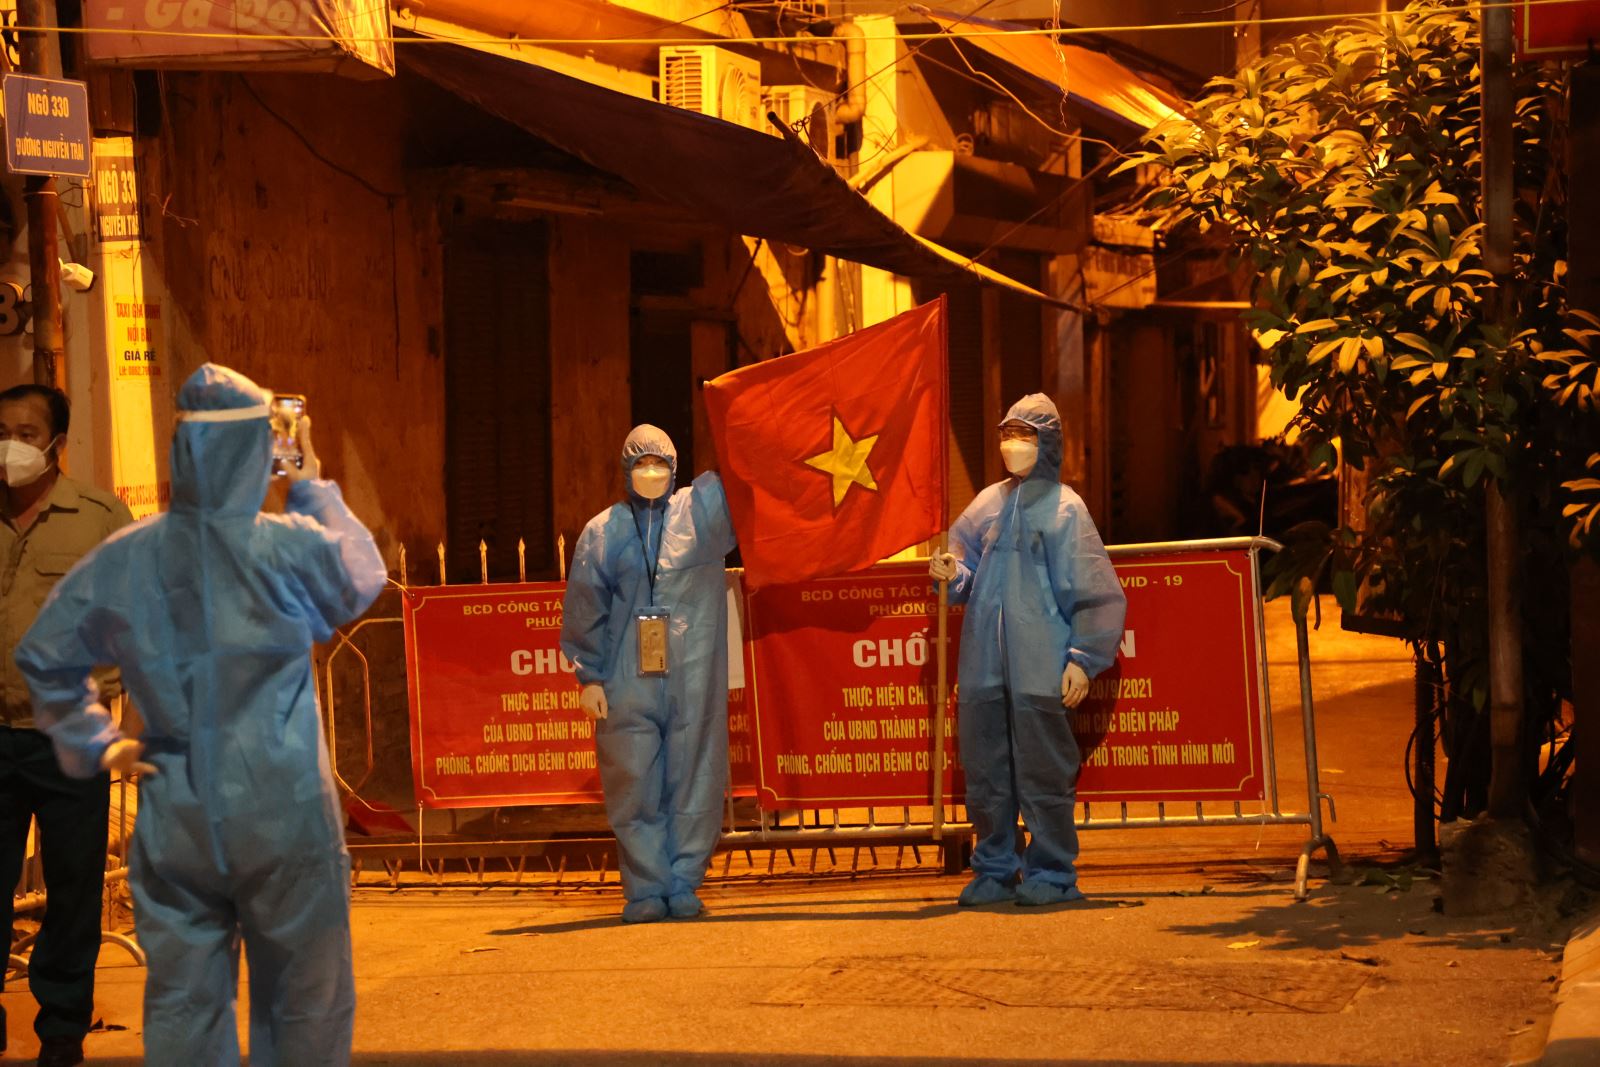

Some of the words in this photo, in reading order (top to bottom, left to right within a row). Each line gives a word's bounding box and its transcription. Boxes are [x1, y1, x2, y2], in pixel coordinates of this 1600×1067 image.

[27, 88, 49, 116] NGÕ
[51, 95, 69, 118] 330
[15, 132, 41, 157] ĐƯỜNG
[42, 133, 69, 159] NGUYỄN
[97, 164, 119, 204] NGÕ
[116, 303, 130, 318] TAXI
[838, 585, 884, 600] CÔNG
[888, 583, 921, 598] TÁC
[1163, 574, 1183, 586] 19
[497, 601, 540, 614] CÔNG
[869, 600, 937, 616] PHƯỜNG
[501, 692, 530, 716] THỰC
[532, 689, 558, 714] HIỆN
[561, 684, 580, 709] CHỈ
[842, 685, 873, 711] THỰC
[876, 682, 905, 710] HIỆN
[483, 716, 504, 744] CỦA
[506, 723, 533, 742] UBND
[536, 718, 569, 741] THÀNH
[823, 712, 846, 741] CỦA
[848, 719, 878, 740] UBND
[880, 714, 916, 739] THÀNH
[1119, 707, 1146, 736] BIỆN
[1149, 706, 1180, 732] PHÁP
[436, 752, 474, 776] PHÒNG,
[476, 748, 510, 774] CHỐNG
[512, 753, 537, 776] DỊCH
[538, 749, 565, 775] BỆNH
[776, 750, 813, 777] PHÒNG,
[815, 746, 852, 774] CHỐNG
[855, 753, 881, 777] DỊCH
[883, 748, 912, 776] BỆNH
[1111, 745, 1149, 766] TRONG
[1152, 740, 1178, 766] TÌNH
[1181, 740, 1209, 765] HÌNH
[1212, 737, 1235, 764] MỚI
